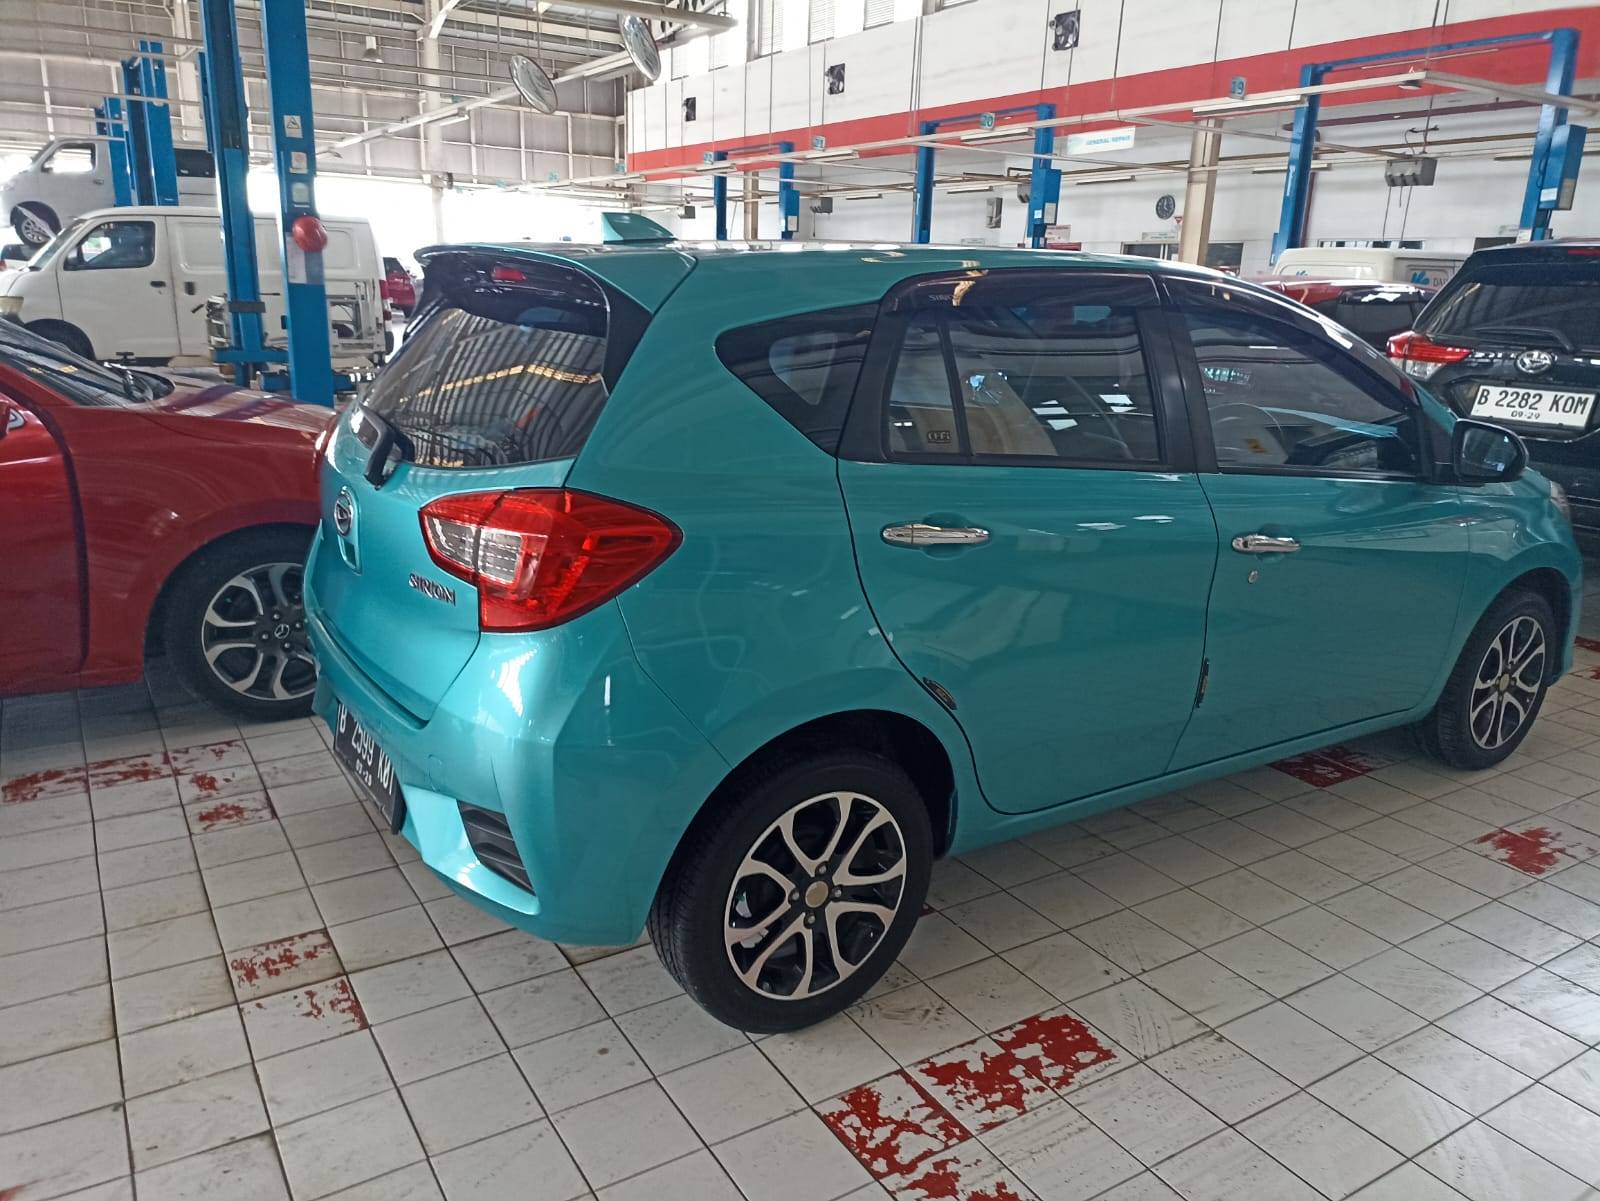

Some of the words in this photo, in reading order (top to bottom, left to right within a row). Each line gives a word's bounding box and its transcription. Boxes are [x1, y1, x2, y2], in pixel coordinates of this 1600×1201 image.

[1231, 80, 1244, 95] 19
[980, 114, 993, 127] 20
[1477, 388, 1490, 405] B
[1495, 390, 1543, 410] 2282
[1549, 394, 1589, 415] KOM
[1511, 410, 1540, 420] 09-29
[408, 572, 456, 607] SIRION
[340, 704, 348, 733] B
[351, 721, 374, 766] 2599
